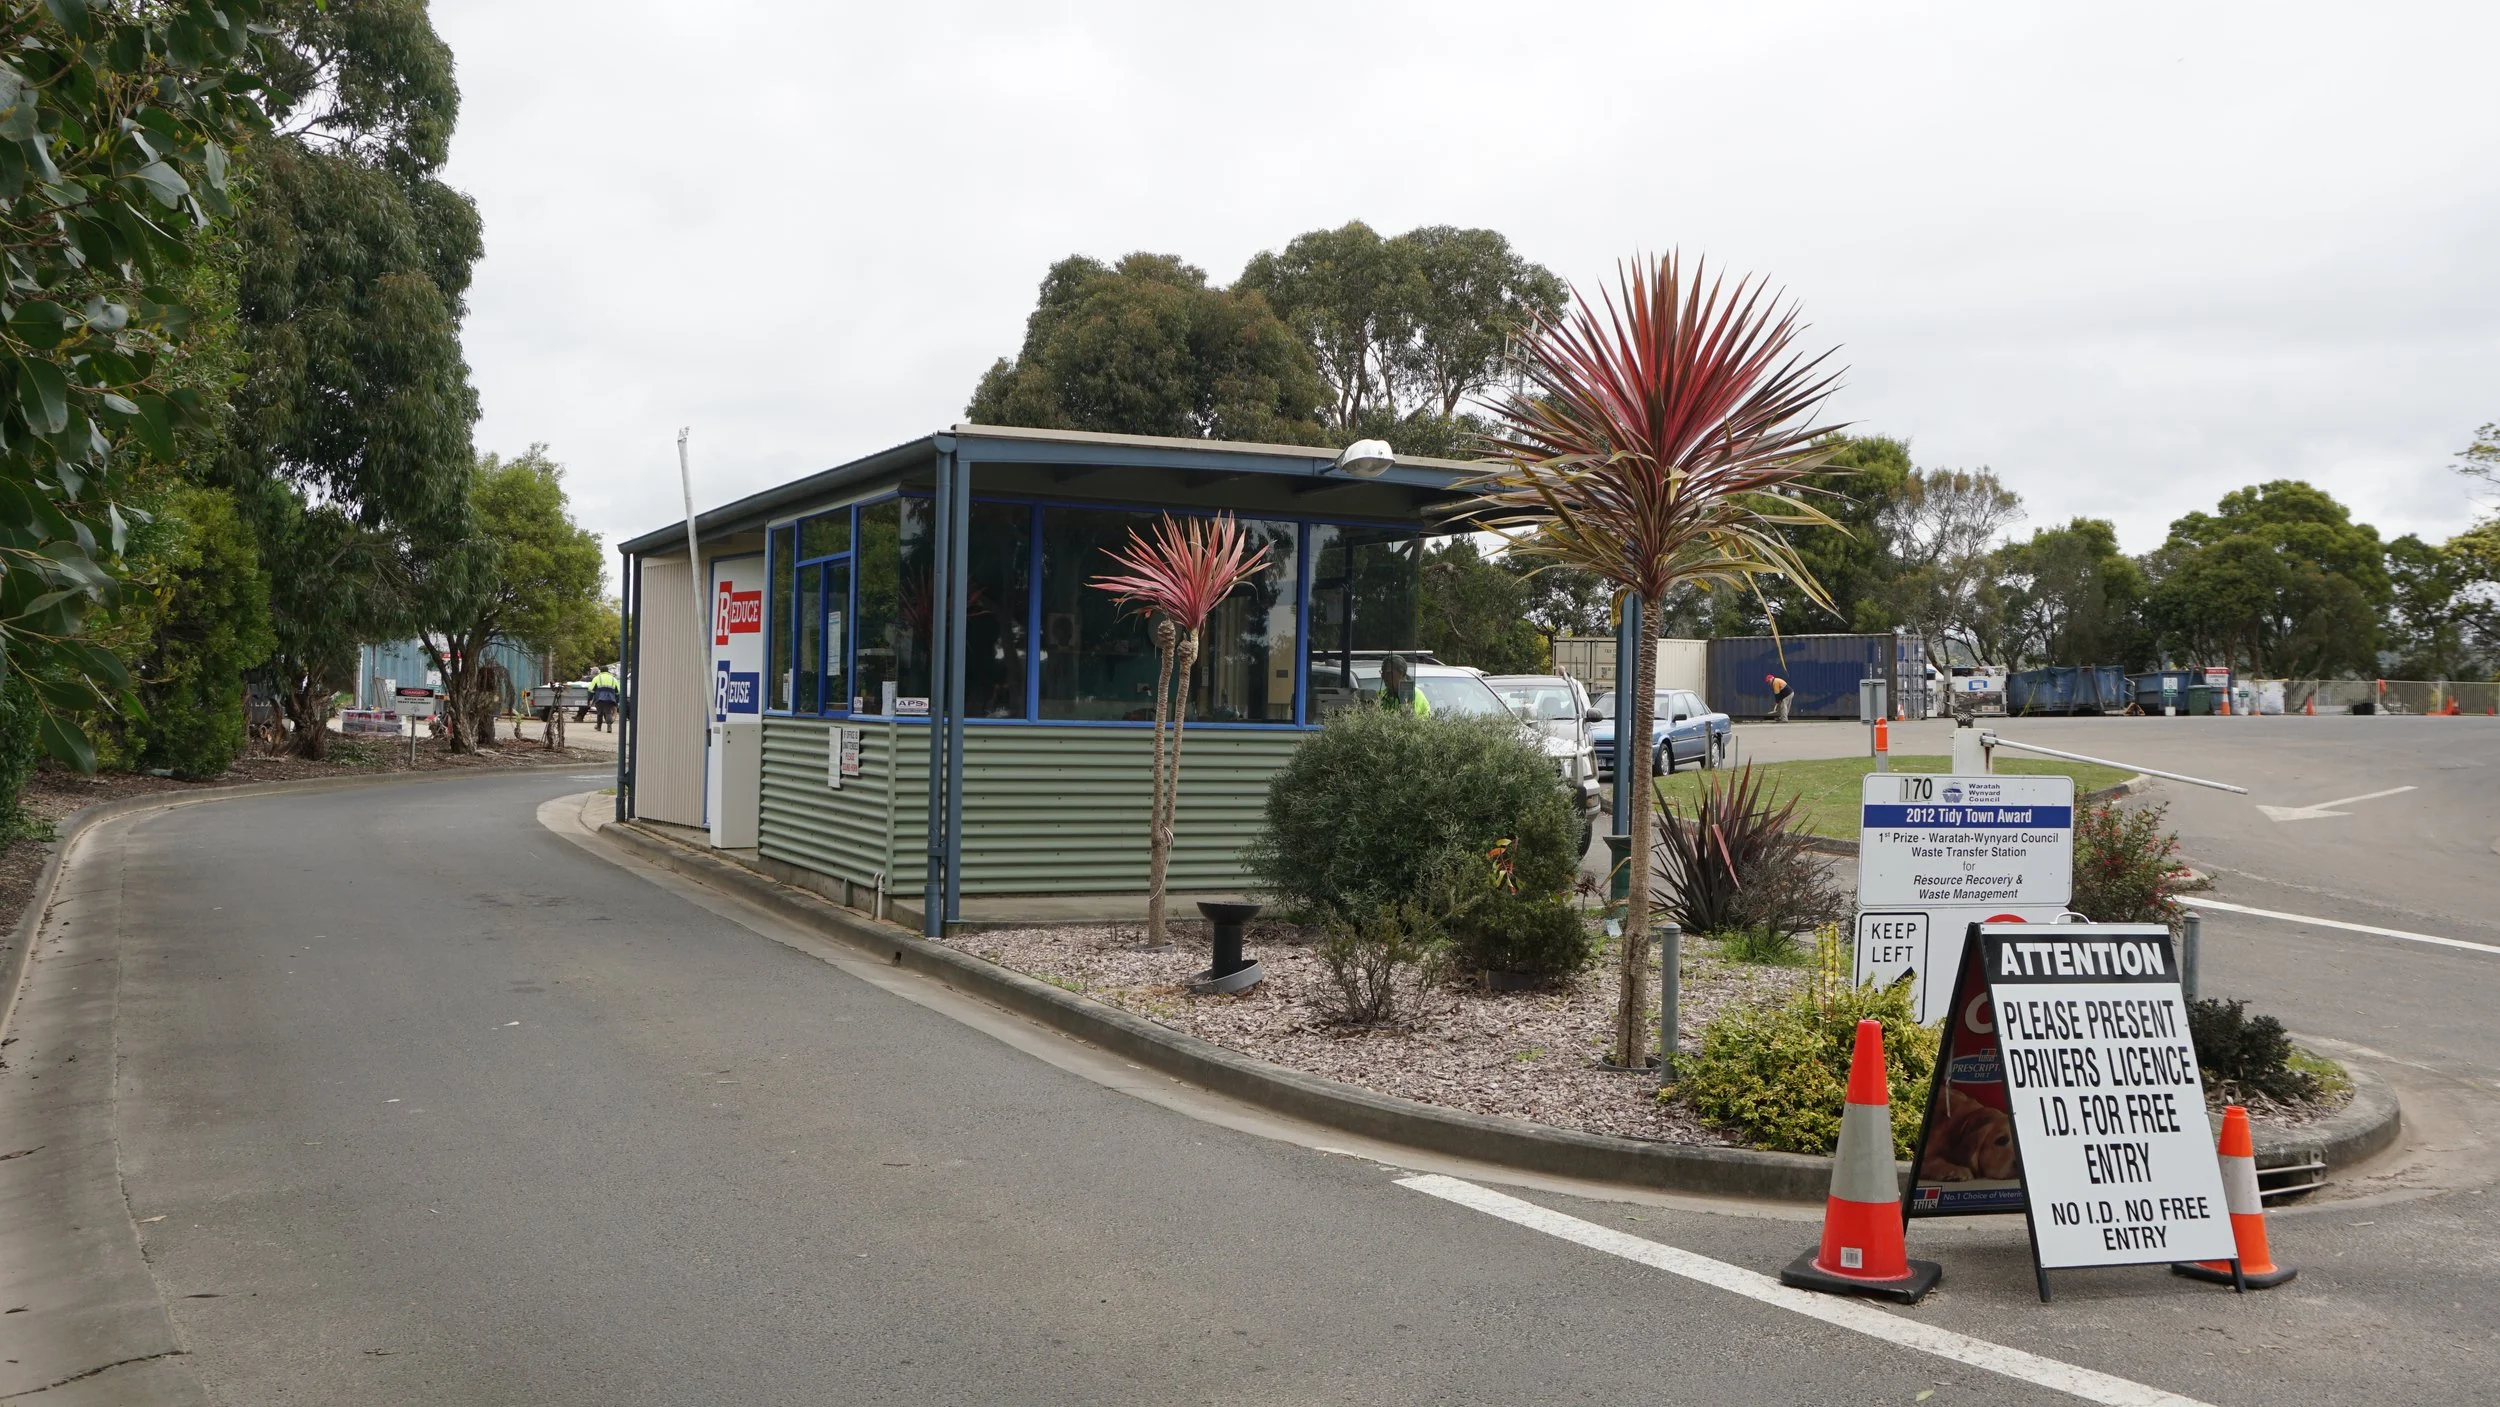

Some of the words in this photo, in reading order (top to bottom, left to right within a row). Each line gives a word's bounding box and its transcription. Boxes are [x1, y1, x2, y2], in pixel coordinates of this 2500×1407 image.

[717, 592, 759, 636] REDUCE
[715, 671, 750, 715] REUSE
[1905, 778, 1933, 800] 170
[1906, 808, 1934, 823] 2012
[1938, 808, 1962, 825] Tidy
[1965, 808, 1994, 823] Town
[1997, 809, 2032, 823] Award
[1879, 832, 1891, 843] 1st
[1893, 832, 1919, 843] Prize
[1929, 832, 2018, 845] Waratah-Wynyard
[2021, 832, 2059, 843] Council
[1912, 847, 1943, 857] Waste
[1946, 847, 1988, 857] Transfer
[1991, 846, 2027, 857] Station
[1962, 861, 1976, 871] for
[1914, 875, 1963, 886] Resource
[1966, 874, 2013, 887] Recovery
[2016, 874, 2023, 884] &
[1919, 889, 1950, 899] Waste
[1953, 889, 2018, 901] Management
[1872, 923, 1916, 939] KEEP
[1872, 946, 1914, 962] LEFT
[2001, 942, 2165, 976] ATTENTION
[2003, 1000, 2084, 1040] PLEASE
[2085, 1000, 2176, 1040] PRESENT
[1952, 1063, 2000, 1072] PRESCRIPT
[2010, 1047, 2100, 1088] DRIVERS
[2107, 1045, 2195, 1086] LICENCE
[2040, 1096, 2077, 1136] I.D.
[2079, 1095, 2124, 1135] FOR
[2125, 1094, 2180, 1134] FREE
[2084, 1142, 2152, 1184] ENTRY
[1963, 1192, 1988, 1200] Choice
[1989, 1191, 1997, 1199] of
[2051, 1201, 2080, 1225] NO
[2086, 1201, 2120, 1224] I.D.
[2125, 1199, 2154, 1222] NO
[2159, 1197, 2210, 1221] FREE
[2103, 1226, 2167, 1250] ENTRY
